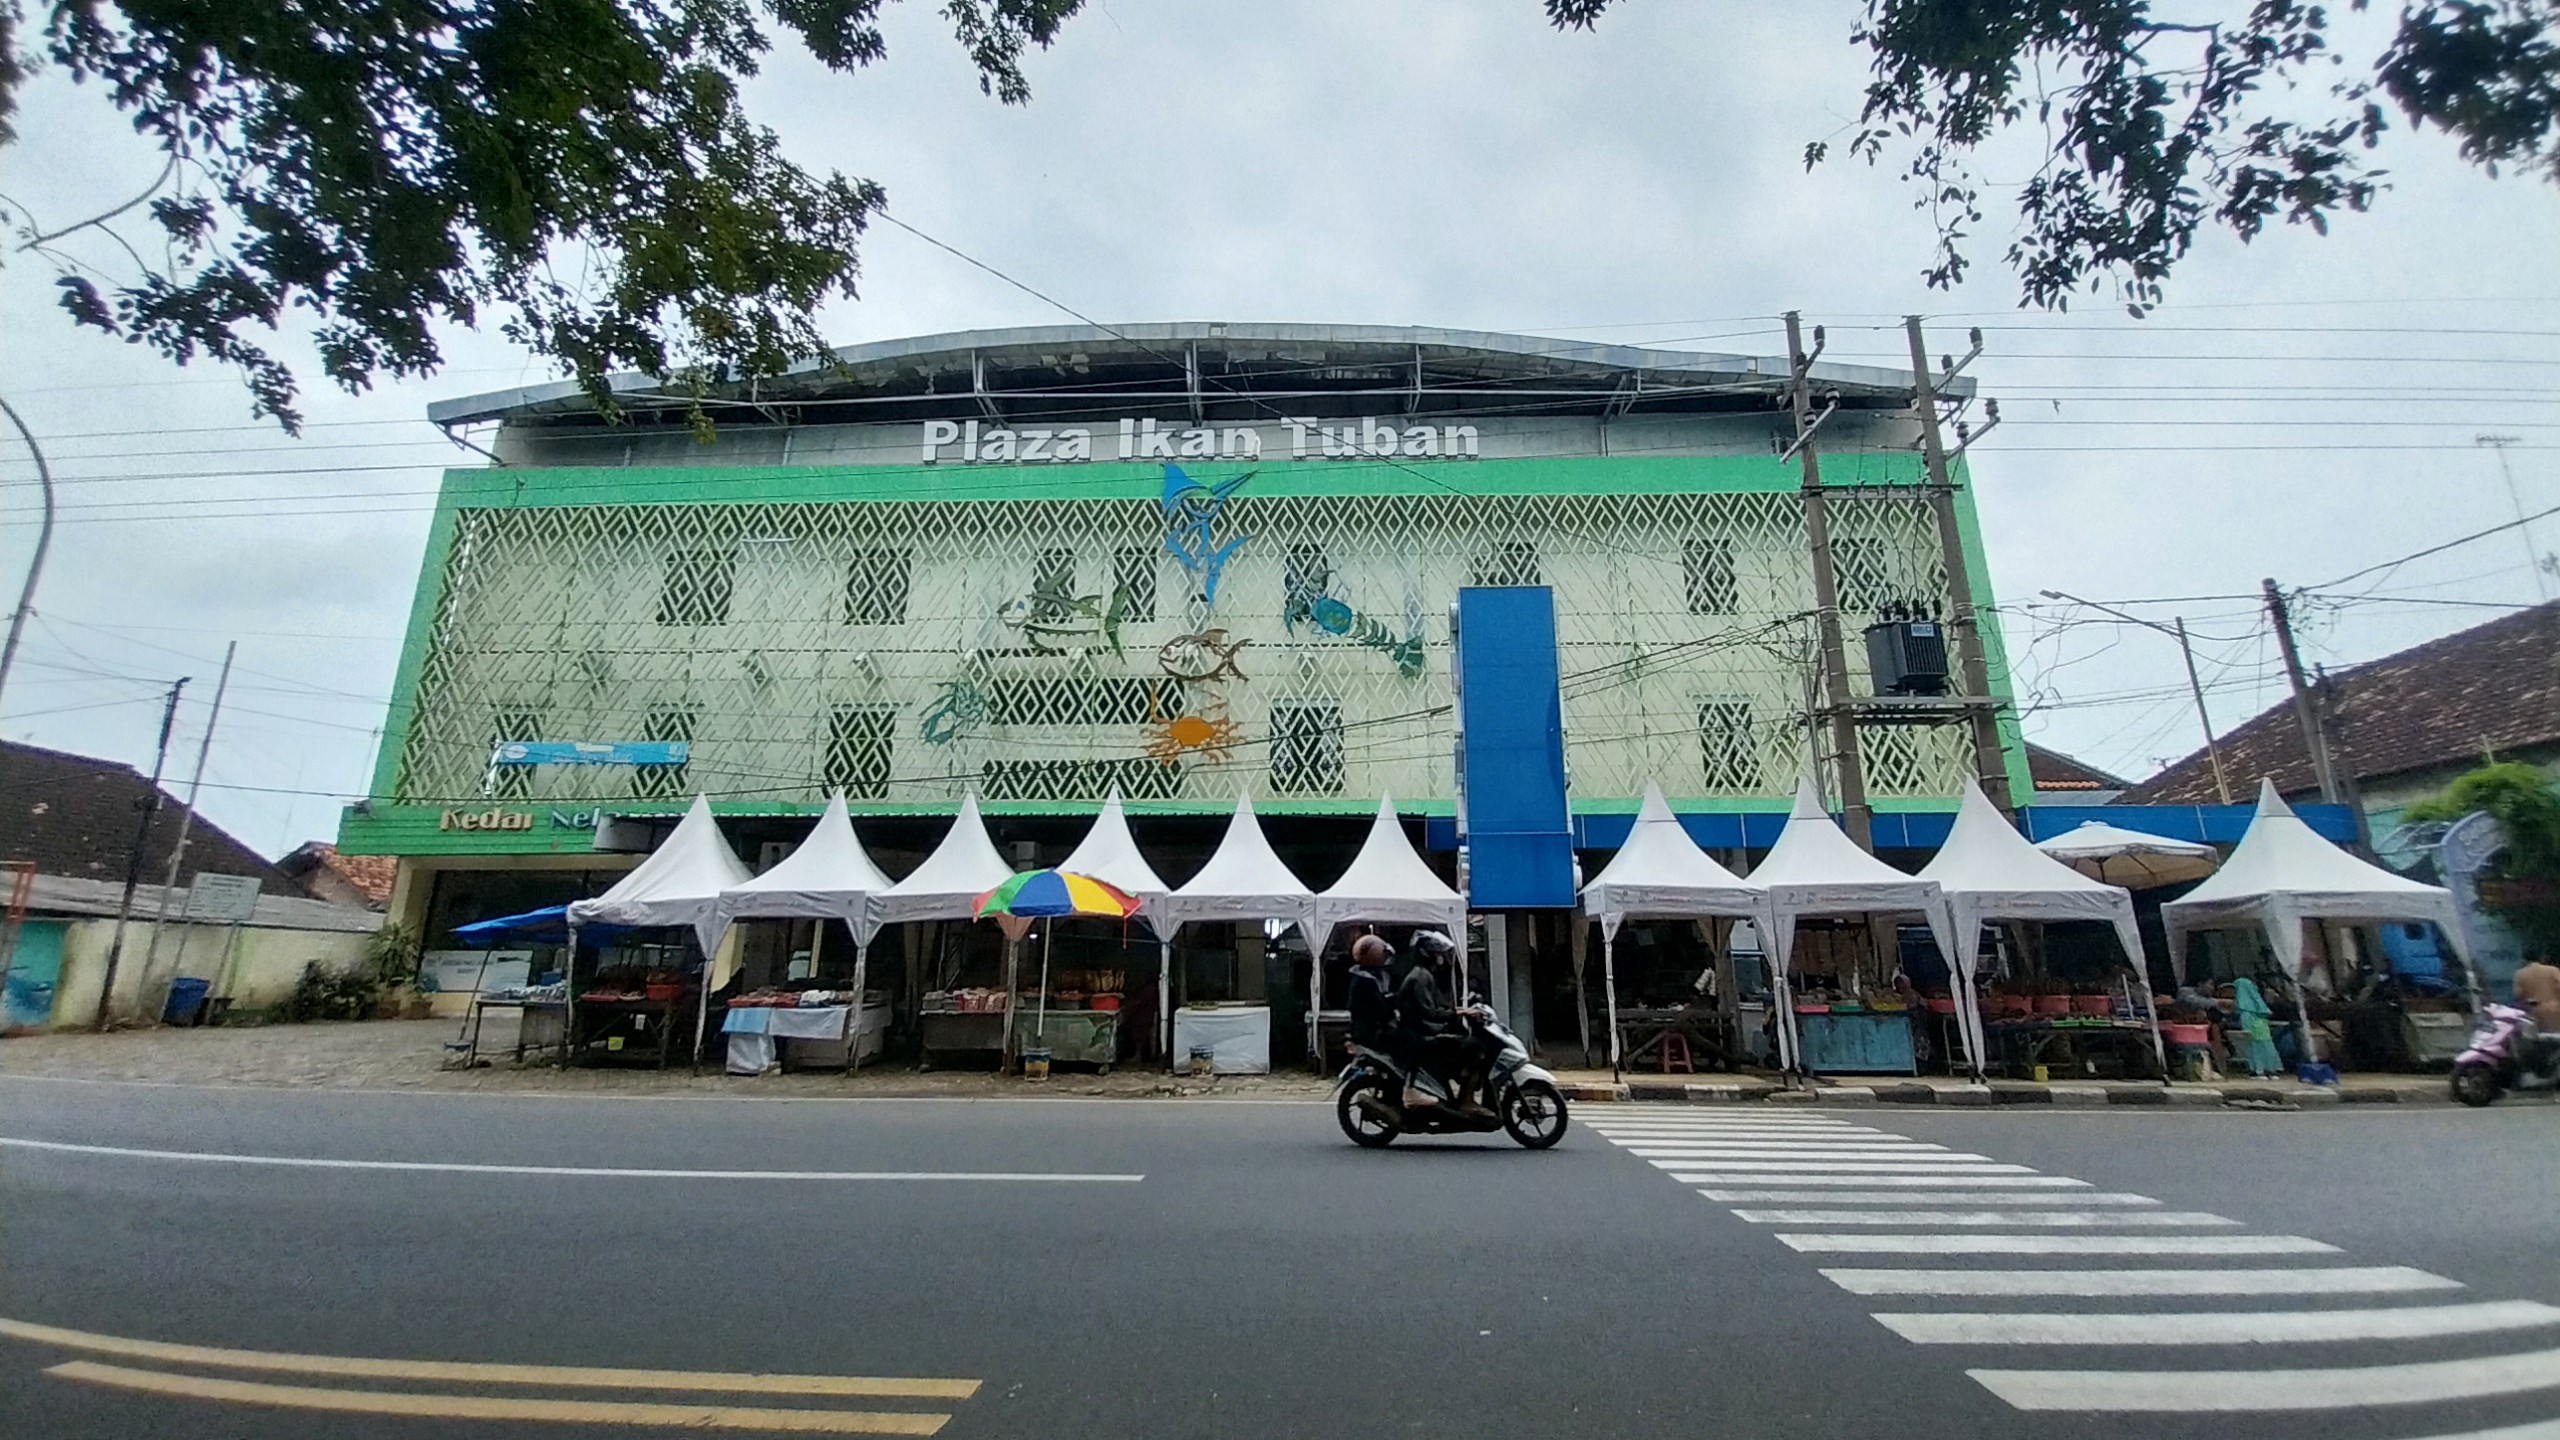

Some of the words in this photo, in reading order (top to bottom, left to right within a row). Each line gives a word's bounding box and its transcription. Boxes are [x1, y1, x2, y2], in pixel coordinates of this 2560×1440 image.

[922, 420, 1091, 461] Plaza
[1119, 417, 1261, 459] Ikan
[1281, 416, 1479, 458] Tuban
[551, 807, 604, 829] Nel
